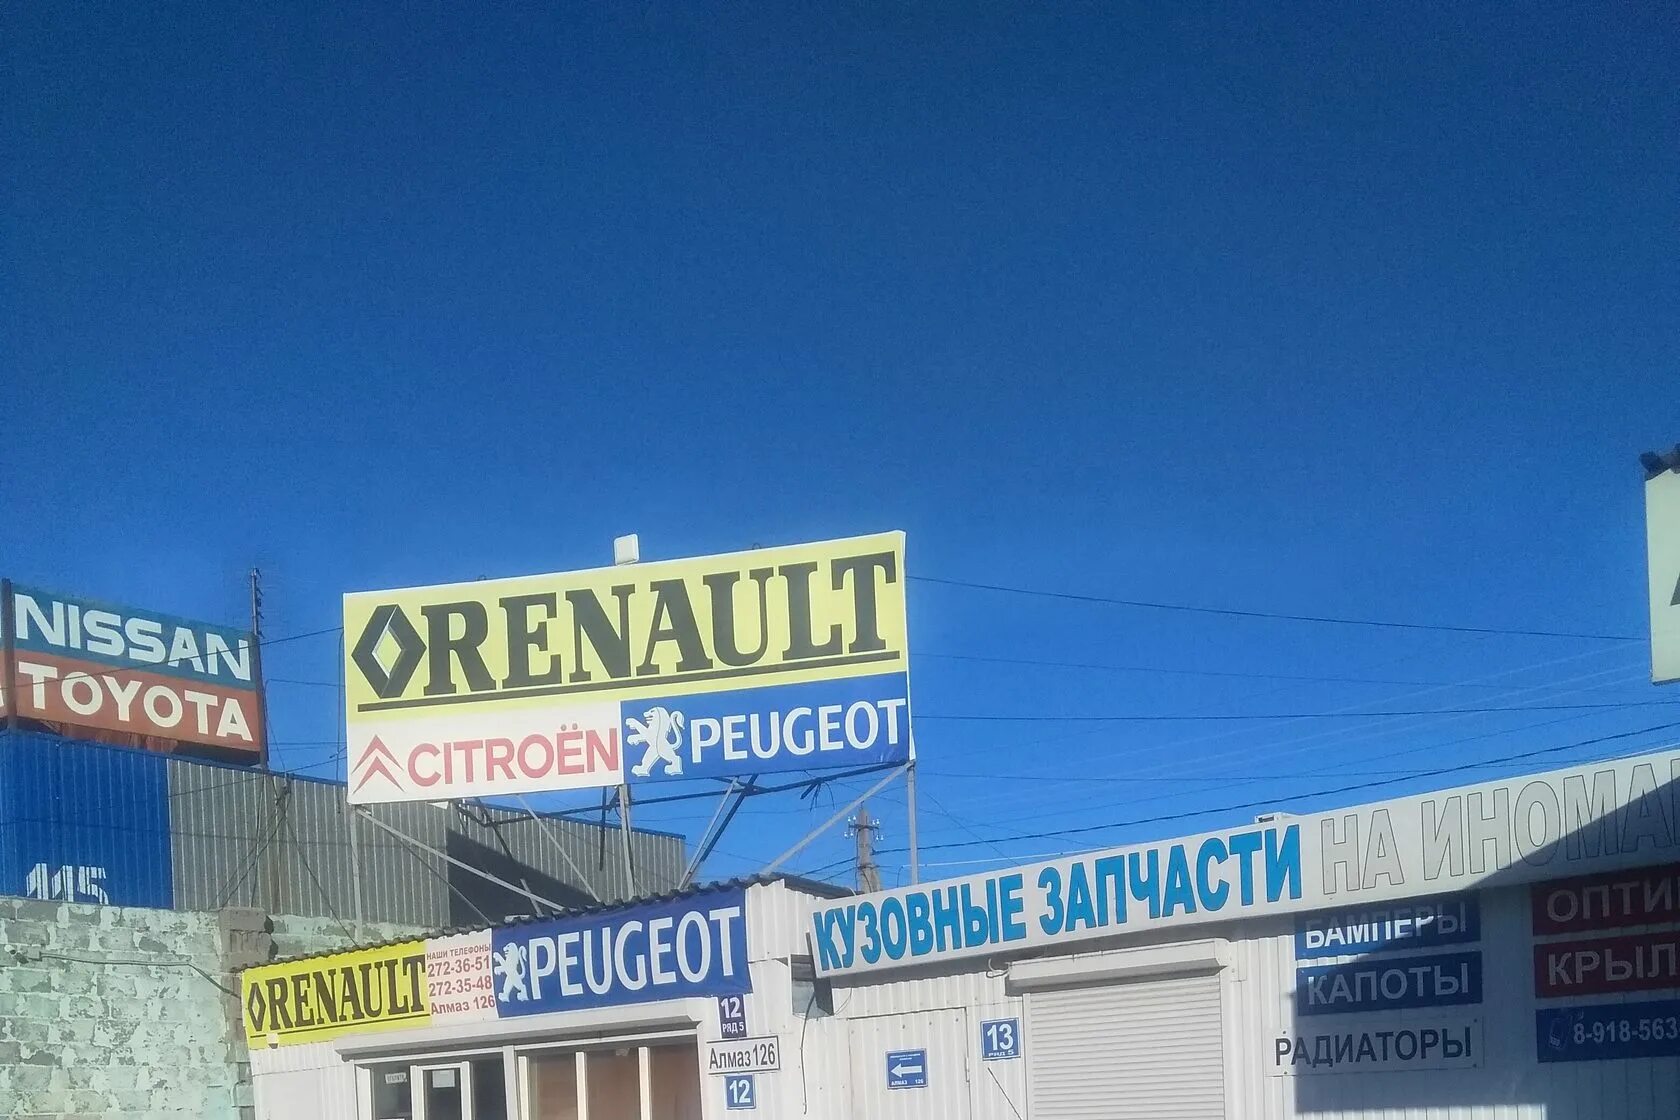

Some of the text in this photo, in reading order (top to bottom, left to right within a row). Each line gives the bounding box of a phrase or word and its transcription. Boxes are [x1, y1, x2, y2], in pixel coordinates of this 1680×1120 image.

[14, 593, 251, 681] NISSAN
[421, 551, 896, 696] RENAULT
[18, 661, 253, 742] TOYOTA
[691, 698, 907, 764] PEUGEOT
[407, 723, 618, 787] CITROËN
[812, 757, 1680, 972] КУЗОВНЫЕ ЗАПЧАСТИ НА ИНОМА
[1547, 876, 1680, 923] ОПТИ
[1304, 901, 1467, 950] БАМПЕРЫ
[426, 943, 491, 961] НАШИ ТЕЛЕФОНЫ
[427, 955, 490, 978] 272-36-51
[528, 906, 740, 1000] PEUGEOT
[1548, 942, 1677, 986] КРЫЛ
[267, 954, 427, 1031] RENAULT
[428, 975, 493, 997] 272-35-48
[431, 994, 496, 1015] Алмаз 126
[1308, 961, 1469, 1006] КАПОТЫ
[720, 997, 742, 1019] 12
[722, 1021, 745, 1034] РЯД 5
[987, 1023, 1014, 1051] 13
[1275, 1026, 1472, 1069] РАДИАТОРЫ
[1573, 1017, 1680, 1045] 8-918-563
[709, 1043, 776, 1070] Алмаз 126
[729, 1079, 751, 1104] 12
